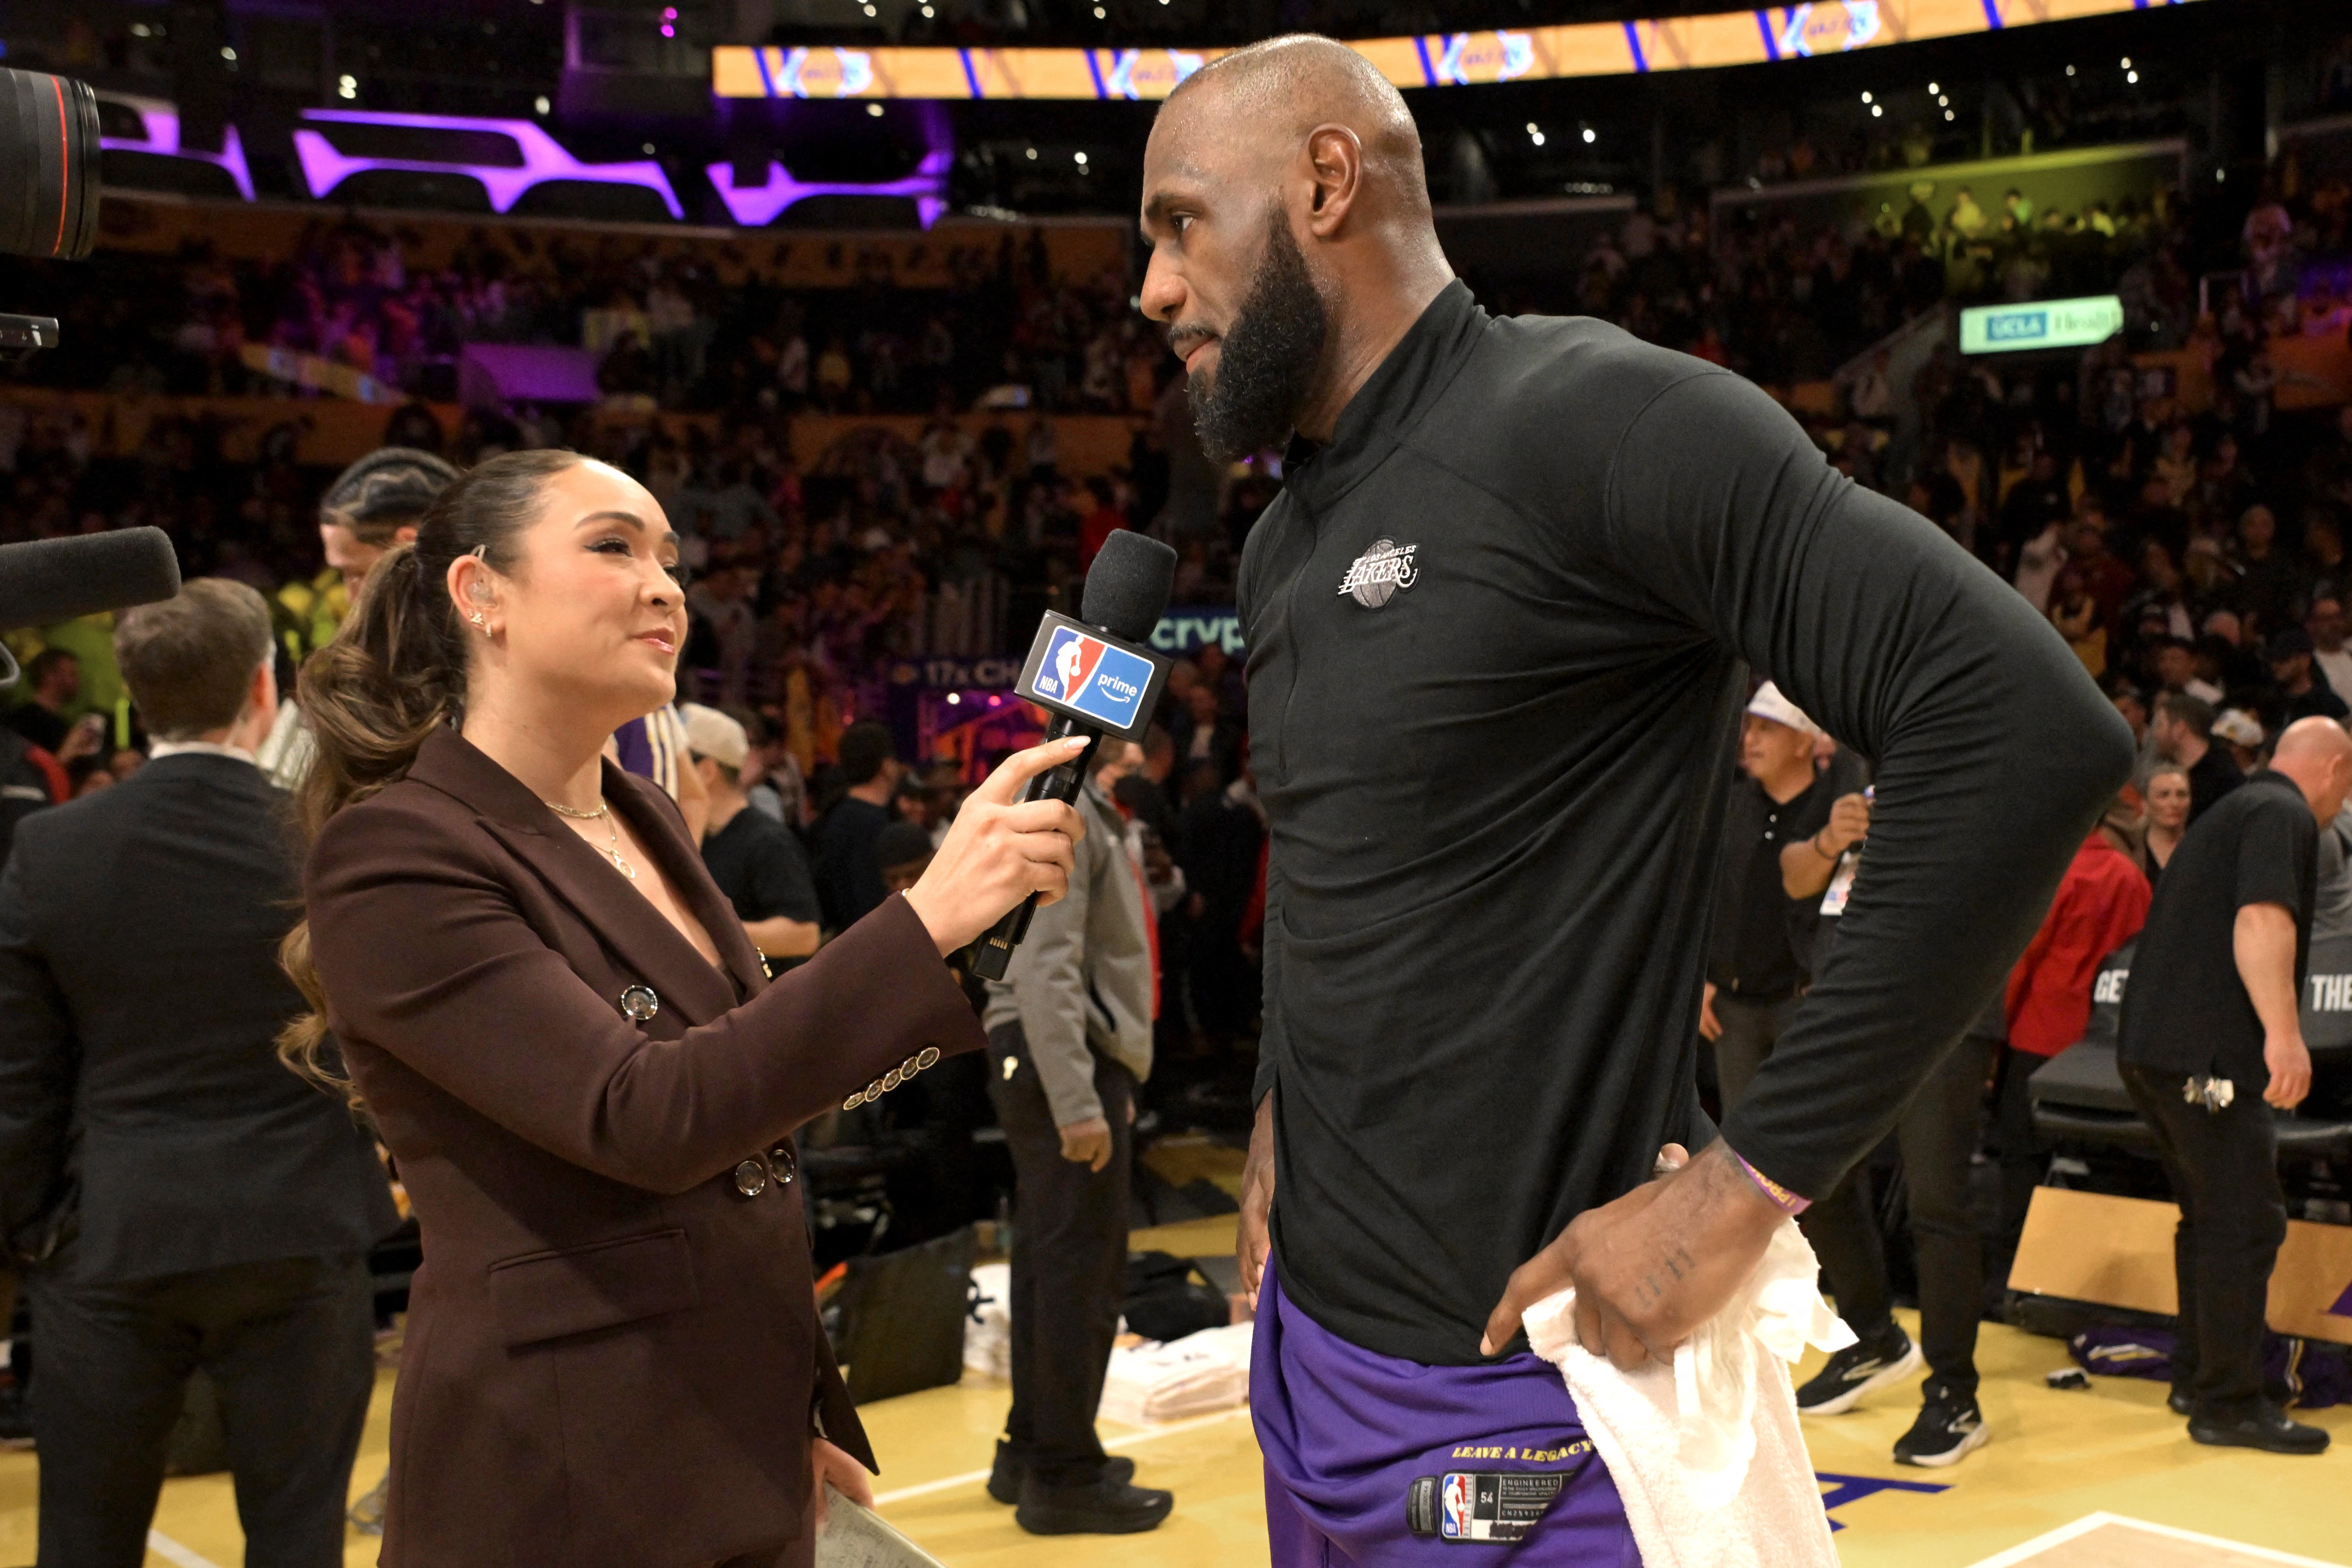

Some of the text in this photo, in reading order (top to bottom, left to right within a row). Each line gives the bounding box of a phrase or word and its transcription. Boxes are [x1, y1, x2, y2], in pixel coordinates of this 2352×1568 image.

[1991, 314, 2042, 338] UCLA
[1338, 555, 1418, 594] LAKERS
[1039, 675, 1058, 694] NBA
[1097, 673, 1138, 698] prime
[1452, 1439, 1592, 1462] LEAVE A LEGACY
[1502, 1479, 1559, 1487] ENGINEERED
[1480, 1492, 1493, 1503] 54
[1446, 1523, 1456, 1534] NBA
